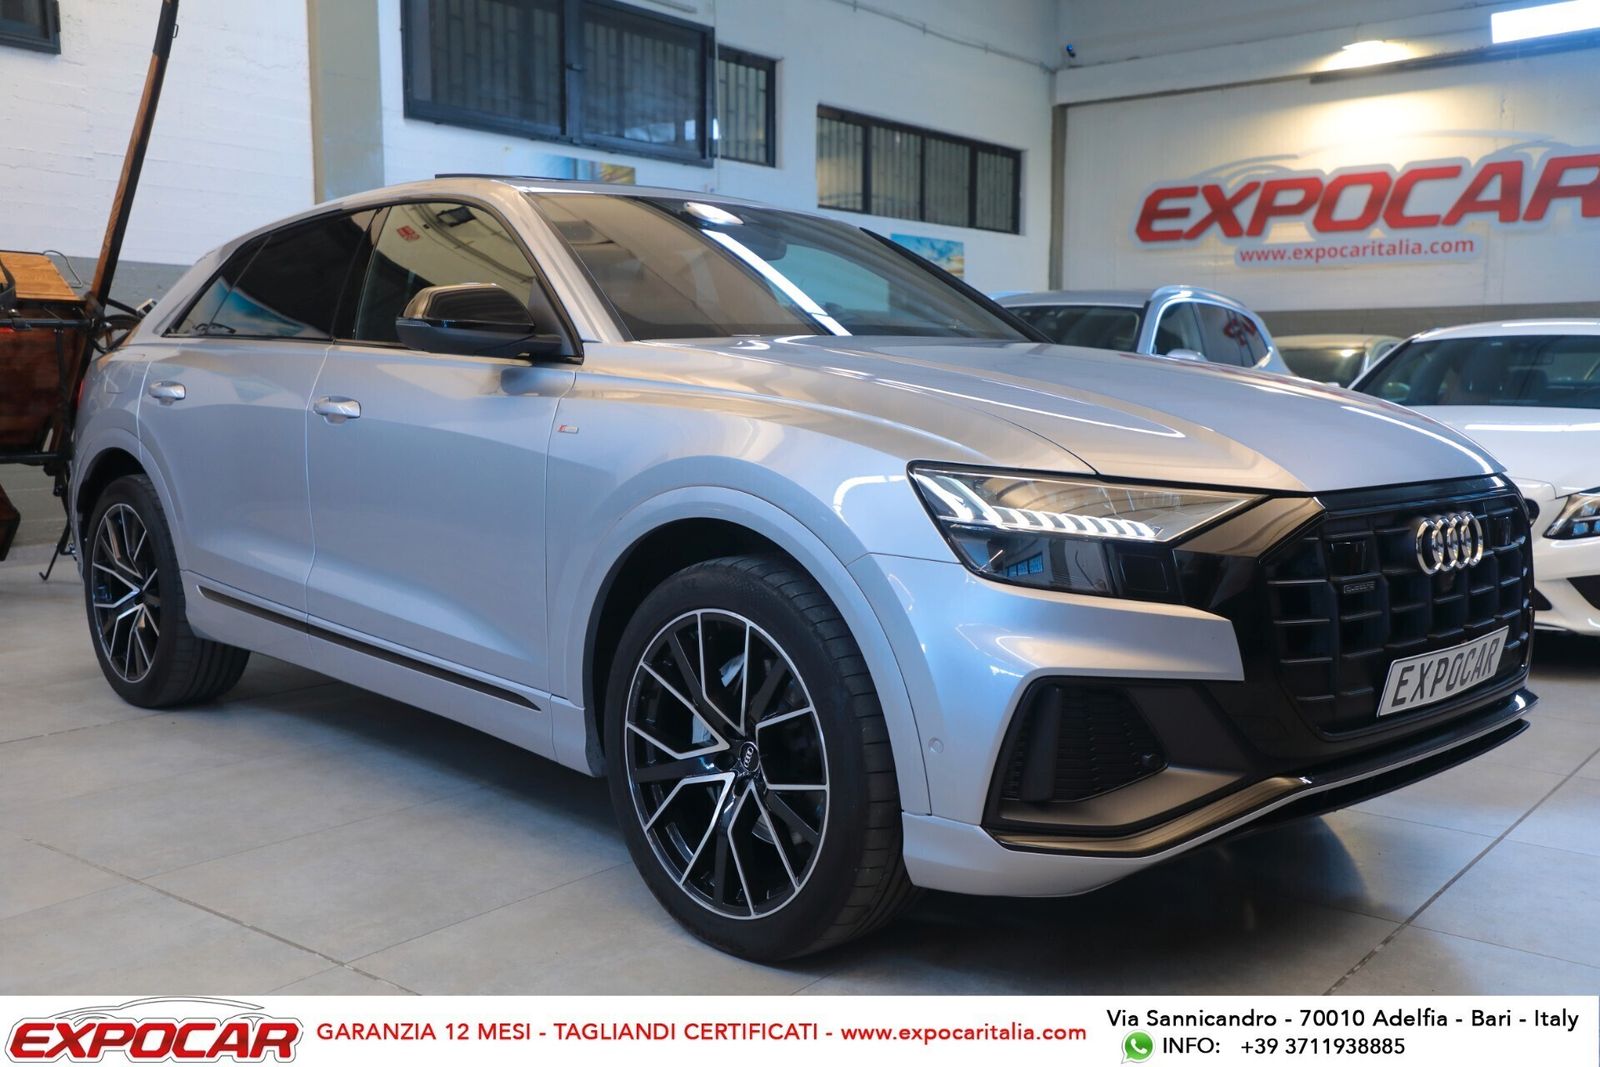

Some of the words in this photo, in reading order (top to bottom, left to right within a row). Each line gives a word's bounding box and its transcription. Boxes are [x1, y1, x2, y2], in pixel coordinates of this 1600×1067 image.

[1136, 154, 1600, 242] EXPOCAR
[1240, 238, 1475, 263] www.expocaritalia.com
[1391, 637, 1501, 708] EXPOCAR
